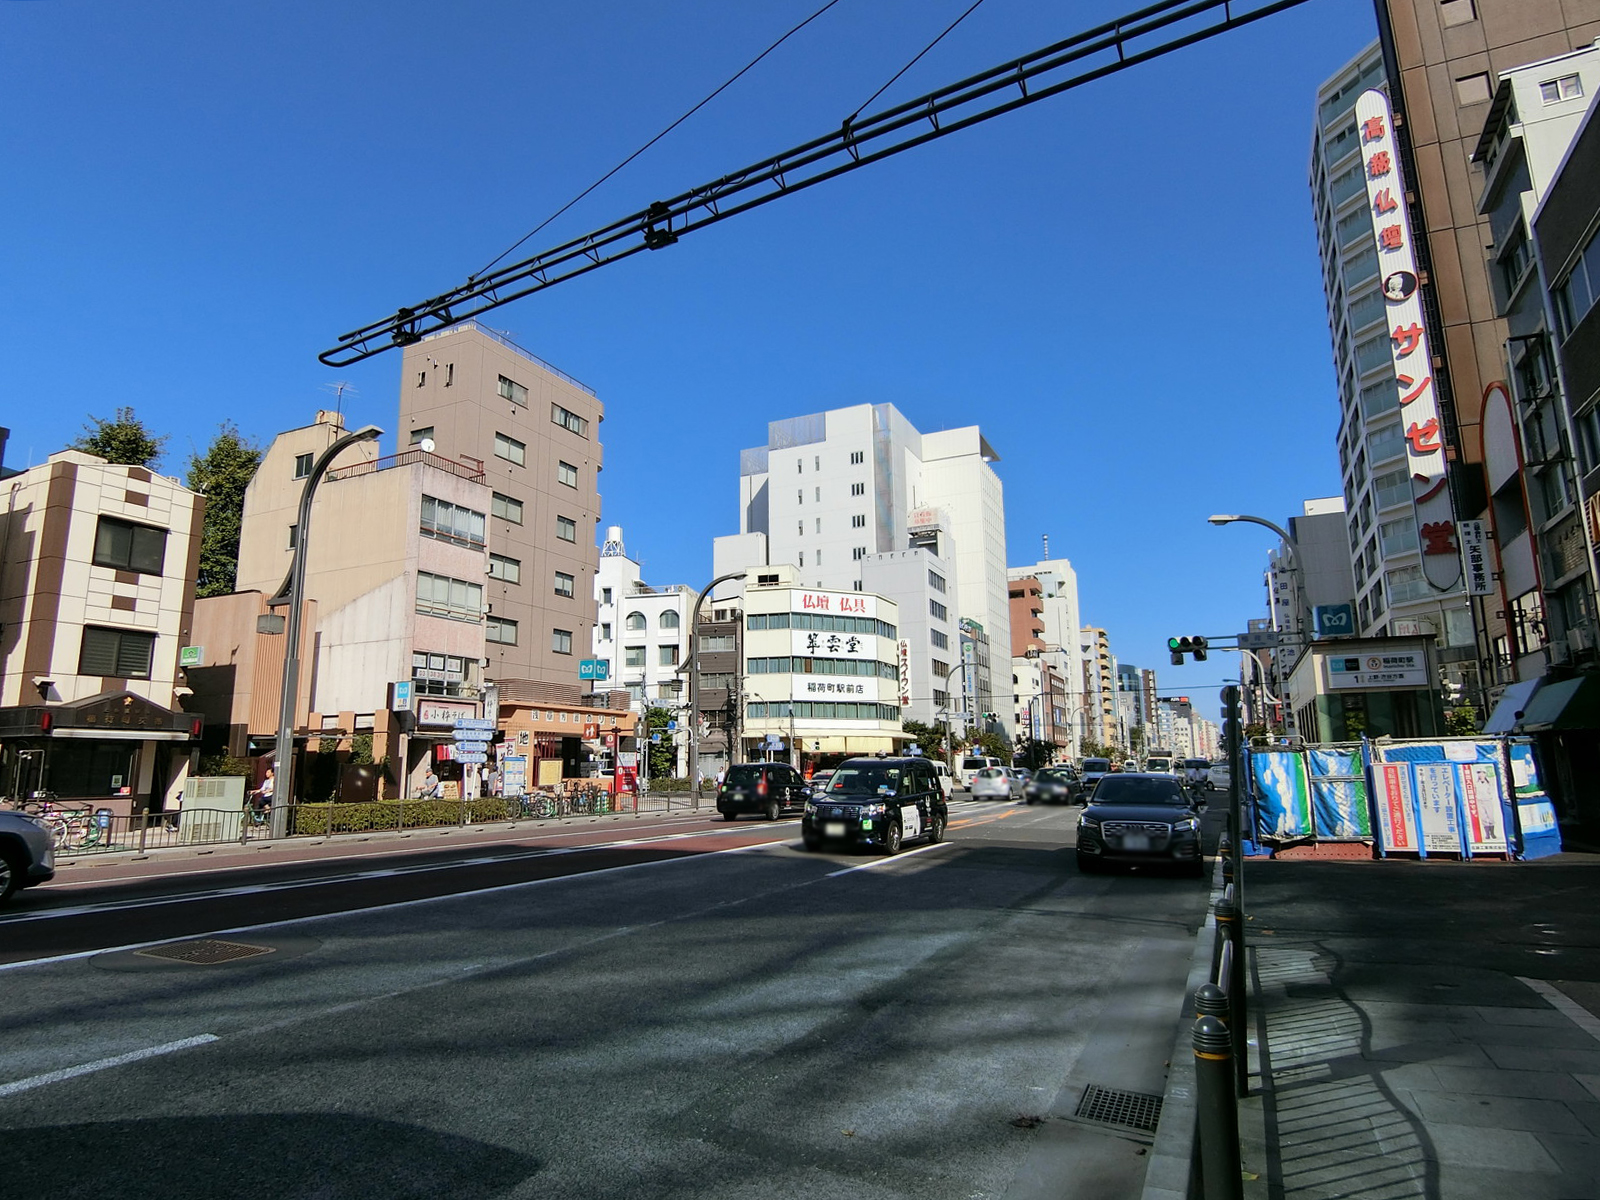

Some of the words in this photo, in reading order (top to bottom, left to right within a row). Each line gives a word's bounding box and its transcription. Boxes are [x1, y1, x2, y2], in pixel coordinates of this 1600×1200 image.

[1364, 115, 1404, 249] 高級仏壇
[1391, 321, 1458, 556] サンゼン堂
[1469, 545, 1486, 592] 矢部事務所
[802, 594, 830, 611] 仏壇
[840, 597, 866, 613] 仏具
[900, 639, 910, 706] 仏壇スイウン堂
[1382, 656, 1415, 664] 稲荷町駅
[807, 681, 864, 694] 稲荷町駅前店
[532, 710, 617, 726] 浅草方面のりば
[1429, 767, 1441, 814] を行っています
